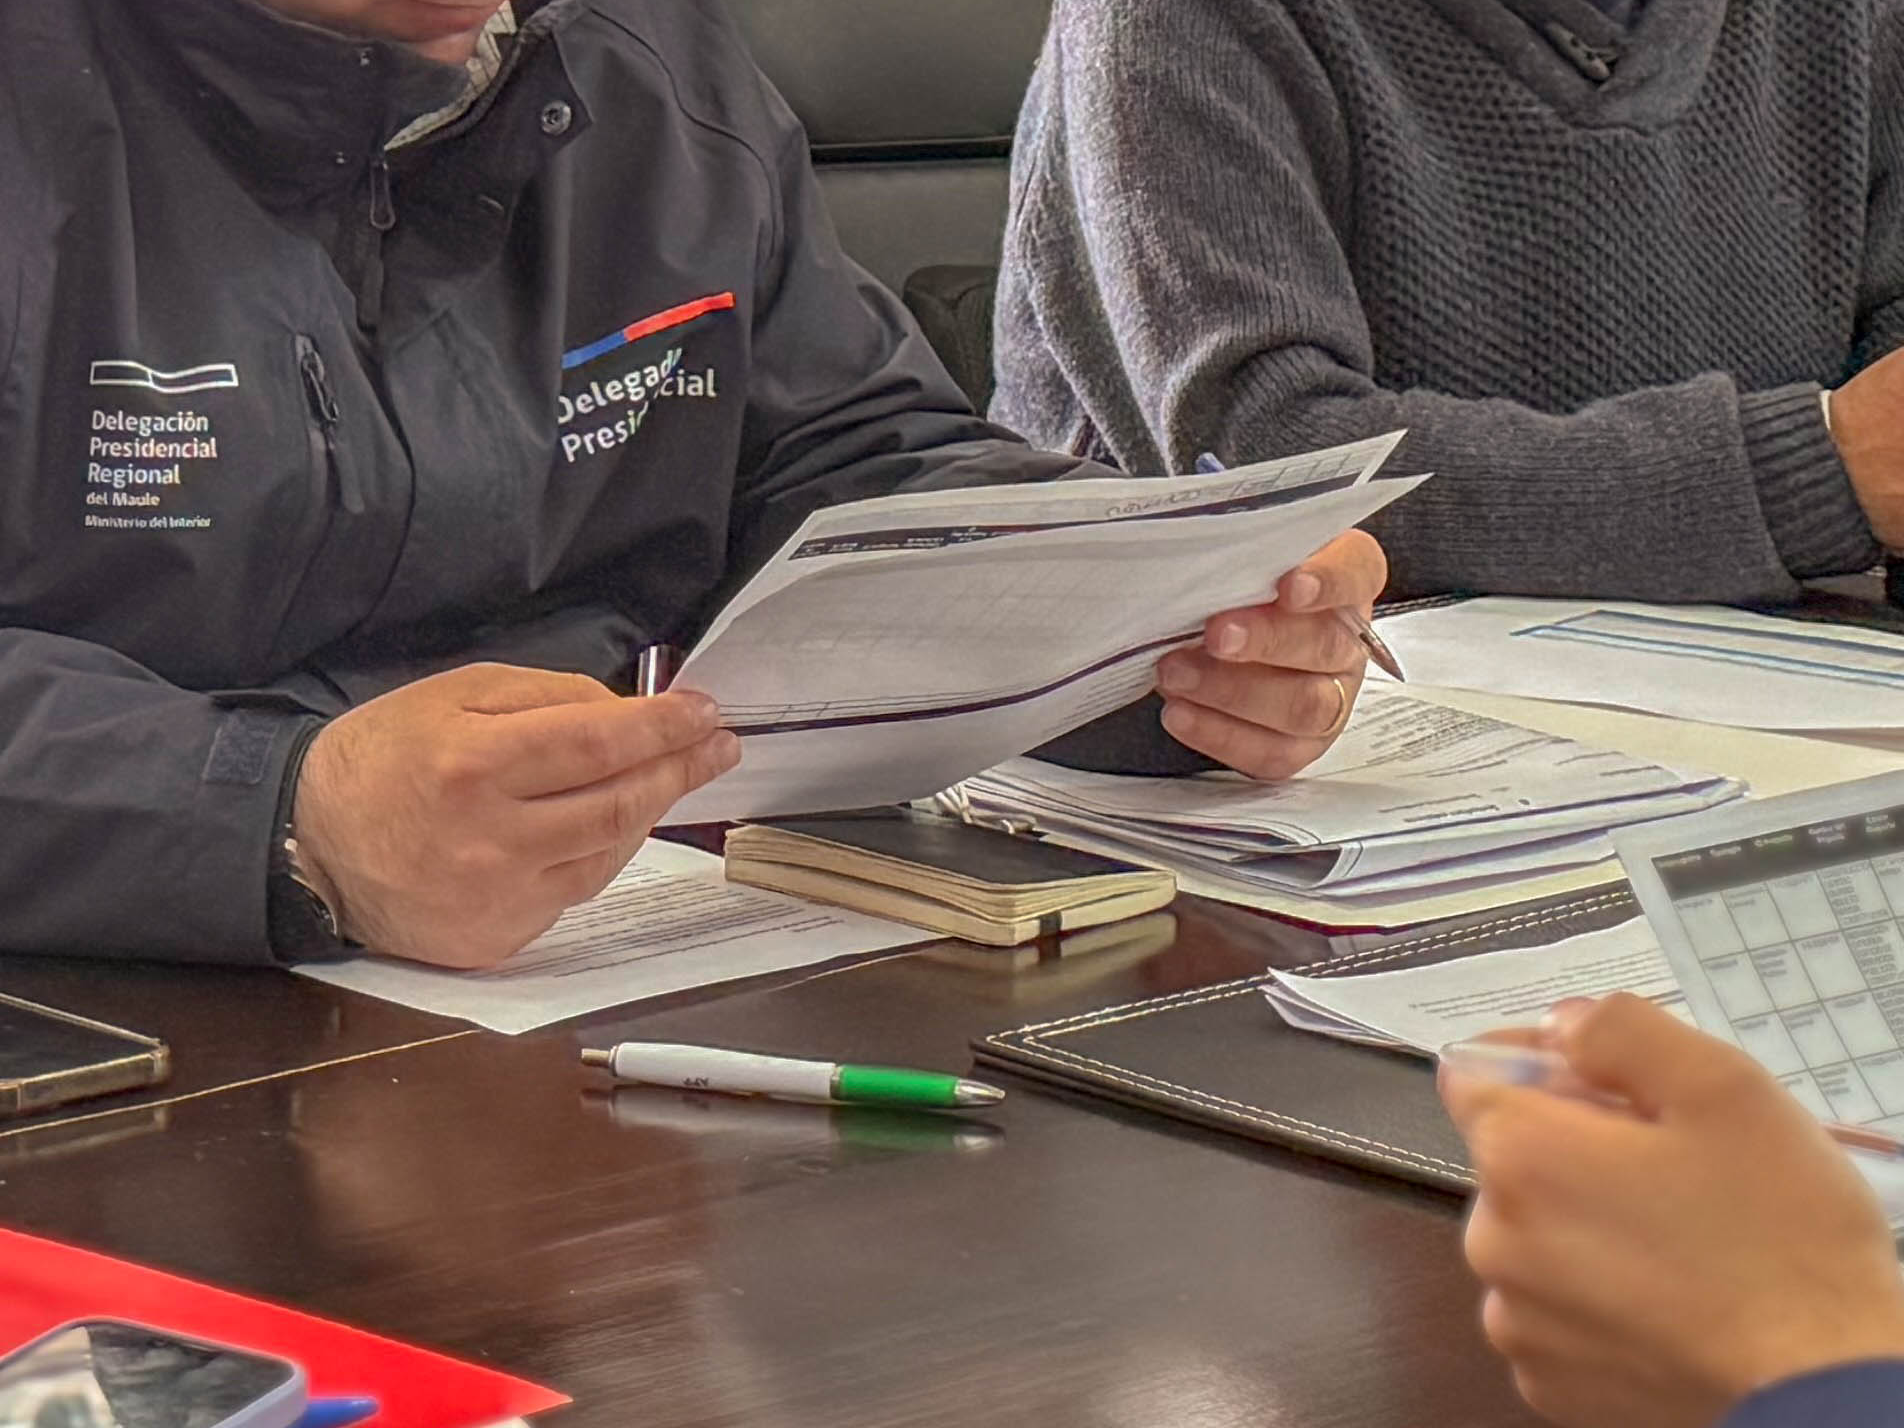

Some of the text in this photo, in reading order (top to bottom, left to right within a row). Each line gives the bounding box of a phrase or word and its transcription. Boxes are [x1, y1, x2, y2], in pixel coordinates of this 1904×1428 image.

[557, 347, 683, 424] Delegad
[91, 409, 209, 437] Delegación
[89, 436, 218, 459] Presidencial
[87, 462, 181, 489] Regional
[86, 491, 161, 506] del Maule
[84, 514, 211, 529] Ministerio del Interior
